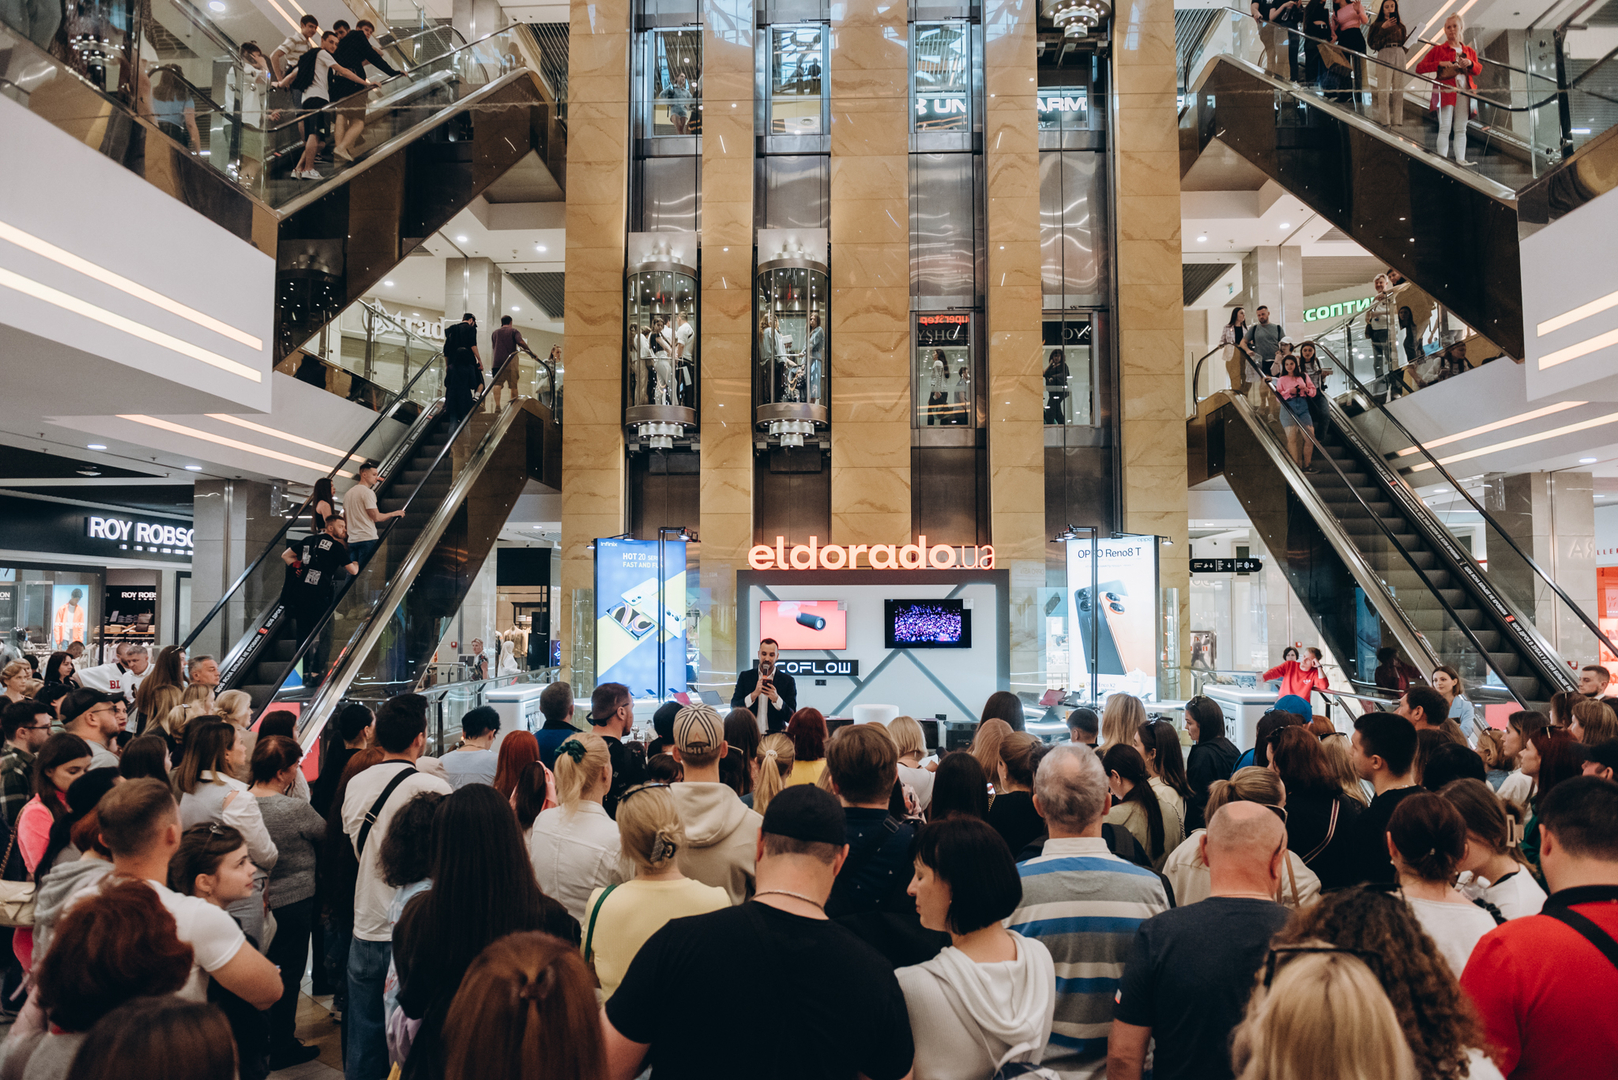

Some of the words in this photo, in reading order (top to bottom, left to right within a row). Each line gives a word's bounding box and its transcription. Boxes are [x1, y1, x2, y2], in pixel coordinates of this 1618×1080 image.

[1038, 97, 1087, 112] ARM
[89, 516, 132, 541] ROY
[622, 552, 637, 560] HOT
[748, 535, 996, 570] eldorado.ua
[1078, 549, 1104, 559] OPO
[1105, 547, 1133, 558] Reno8
[1135, 547, 1142, 556] T
[774, 661, 851, 674] COFLOW
